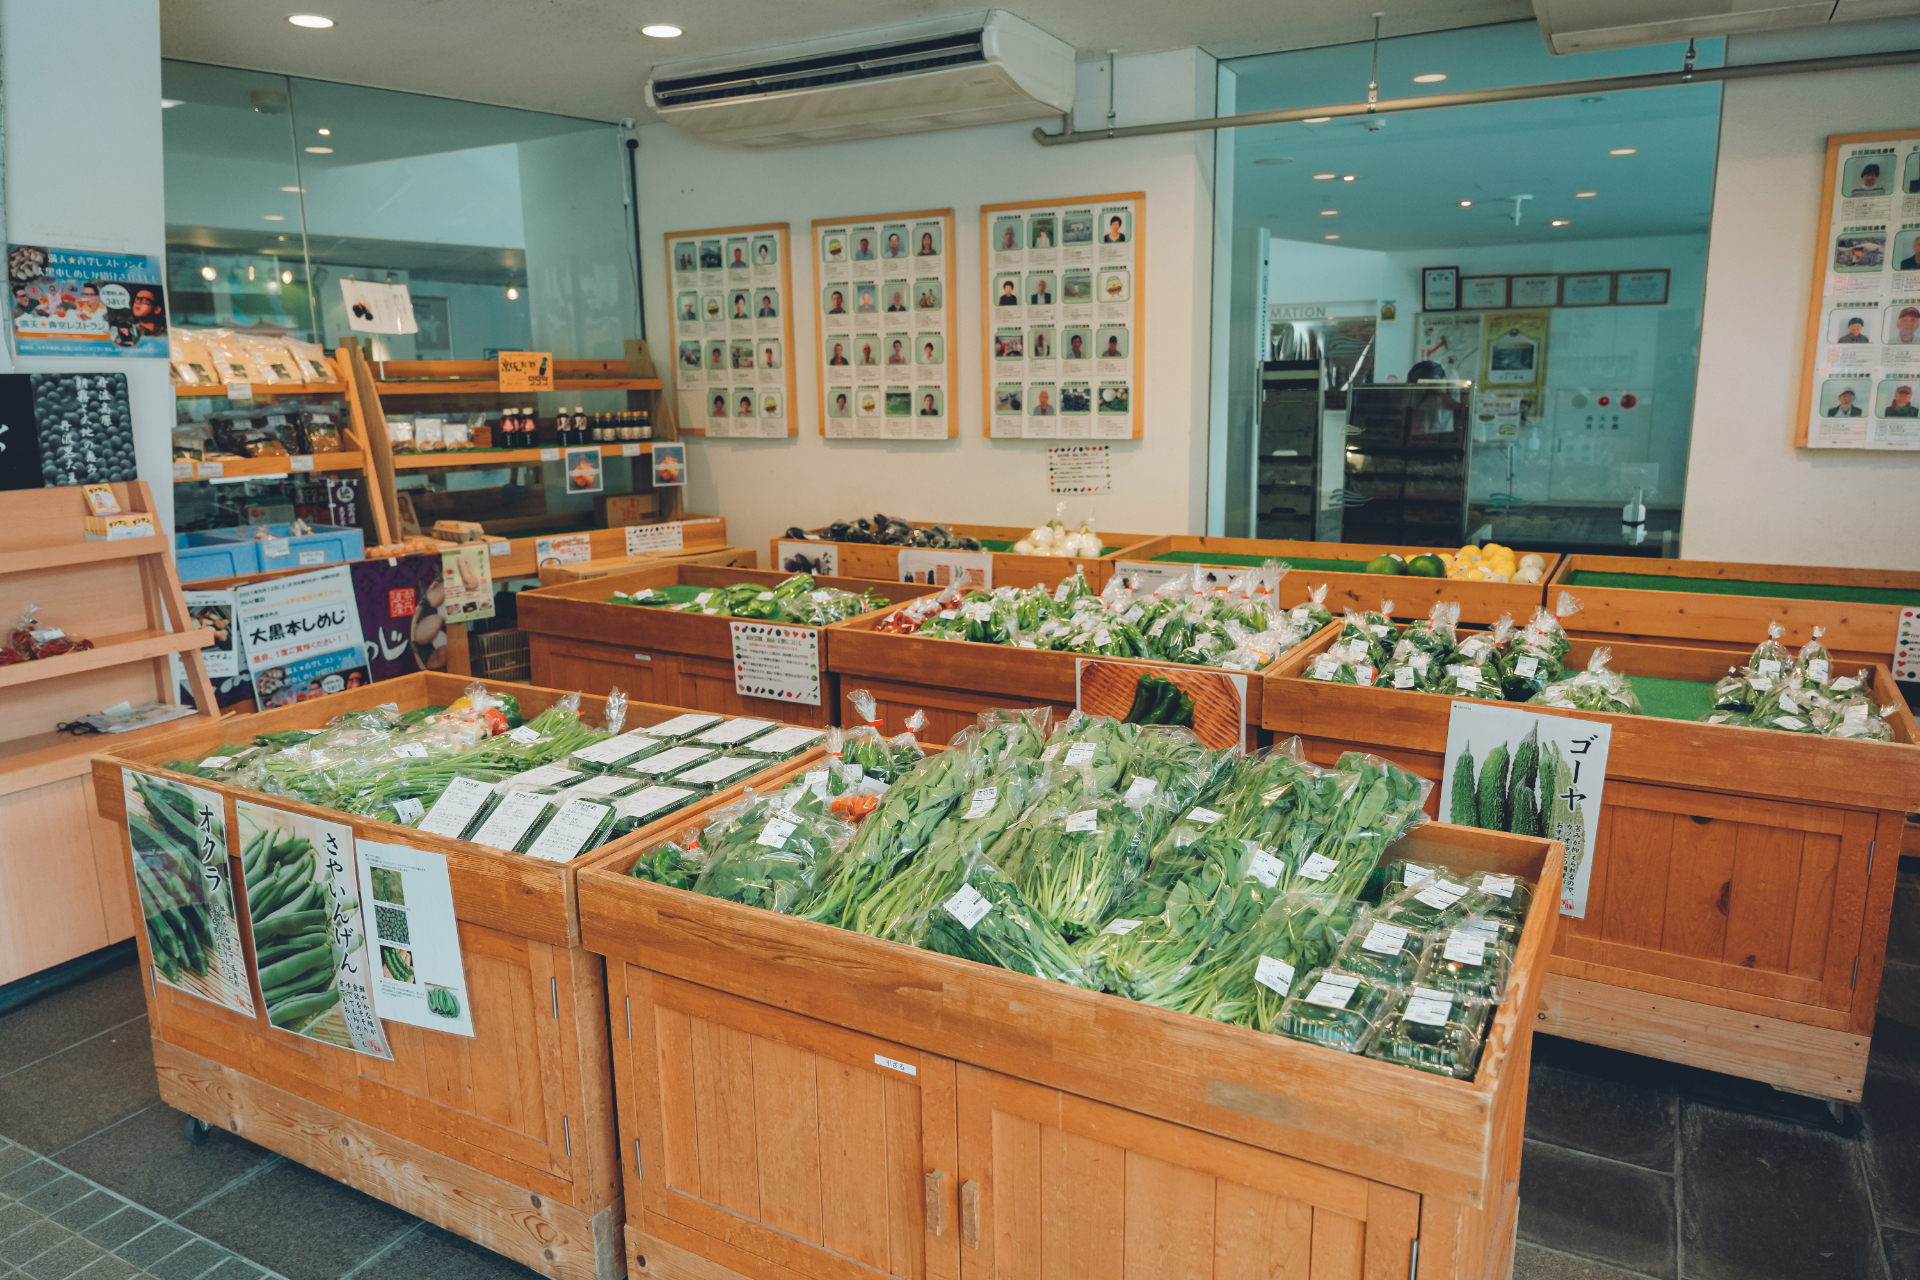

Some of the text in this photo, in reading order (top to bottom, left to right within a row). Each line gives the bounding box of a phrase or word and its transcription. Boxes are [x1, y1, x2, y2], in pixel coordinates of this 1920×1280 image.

[97, 376, 112, 427] 丹波高原
[59, 420, 78, 484] 丹波黒大豆
[249, 610, 345, 646] 大黒本しめじ
[1559, 734, 1598, 811] ゴーヤ
[197, 804, 222, 892] オクラ
[326, 832, 357, 974] さやいんげん
